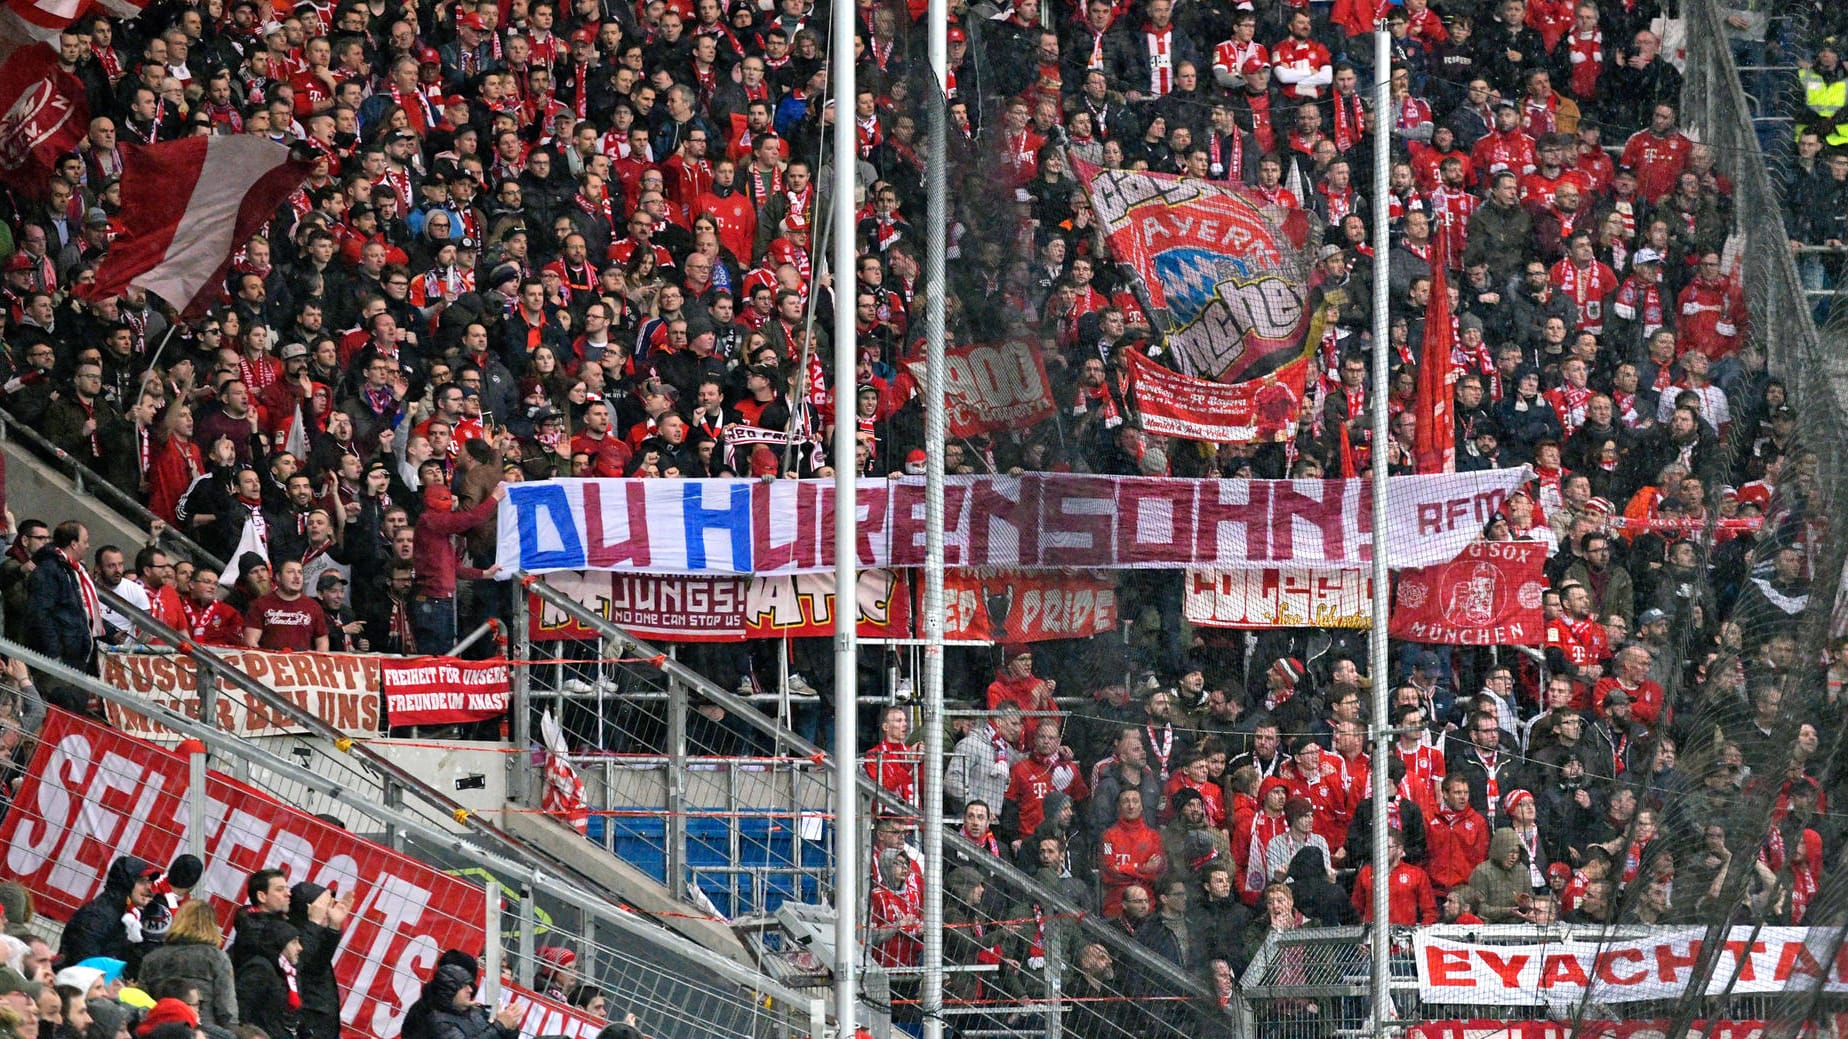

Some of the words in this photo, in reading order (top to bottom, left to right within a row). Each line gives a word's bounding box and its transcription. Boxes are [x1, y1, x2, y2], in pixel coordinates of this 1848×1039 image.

[508, 482, 651, 569] DU
[1417, 488, 1506, 535] RFM
[615, 577, 745, 613] JUNGS!
[1021, 588, 1115, 634] PRIDE
[615, 611, 632, 624] NO
[662, 612, 686, 626] CAN
[690, 614, 721, 626] STOP
[725, 614, 741, 627] US
[1409, 621, 1525, 644] MÜNCHEN
[104, 653, 380, 692] AUSGSPERRTE
[384, 666, 437, 686] FREIHEIT
[439, 663, 461, 684] FÜR
[463, 665, 509, 686] UNSERE
[317, 690, 379, 732] UNS
[387, 692, 448, 713] FREUNDE
